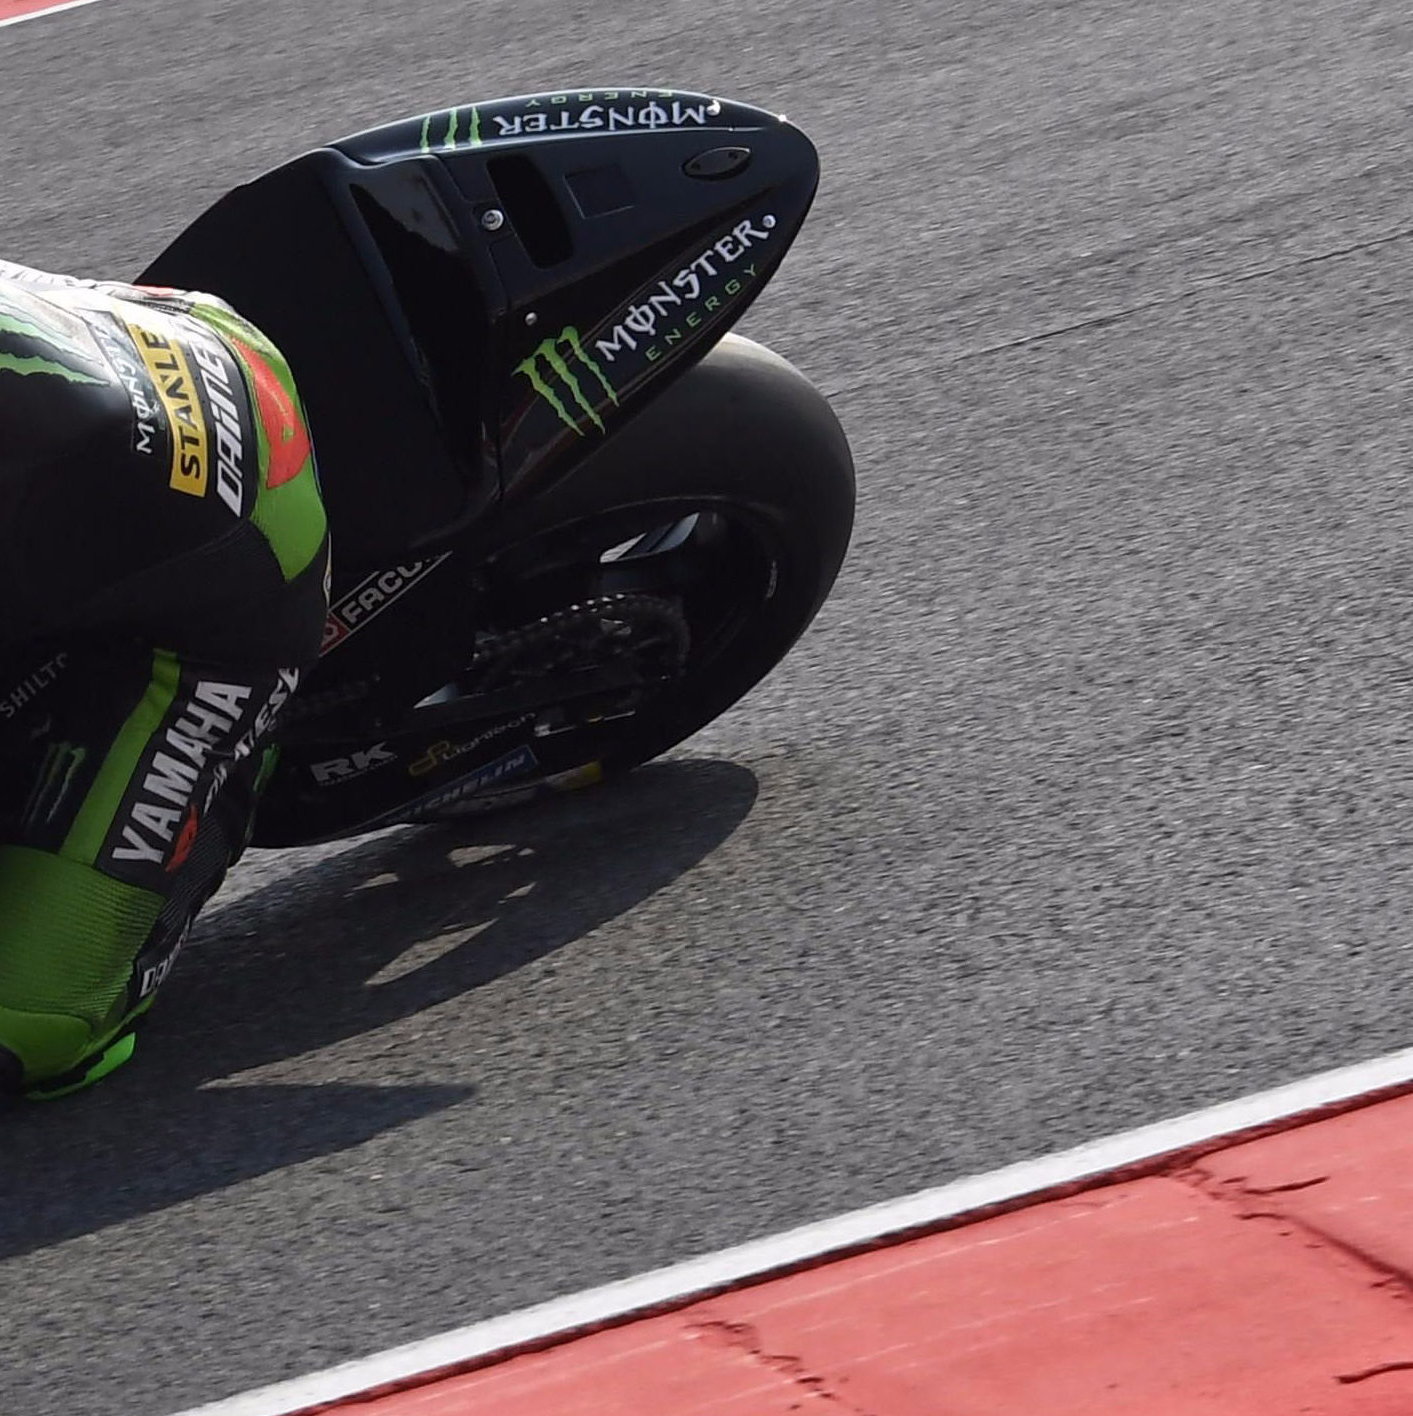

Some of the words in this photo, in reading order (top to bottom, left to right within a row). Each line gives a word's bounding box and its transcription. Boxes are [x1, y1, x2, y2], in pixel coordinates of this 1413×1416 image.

[493, 101, 707, 136] MONSTER
[595, 218, 769, 362] MONSTER
[646, 263, 758, 363] ENERGY
[140, 327, 202, 480] STANLE
[112, 680, 253, 865] YAMAHA
[309, 741, 396, 783] RK
